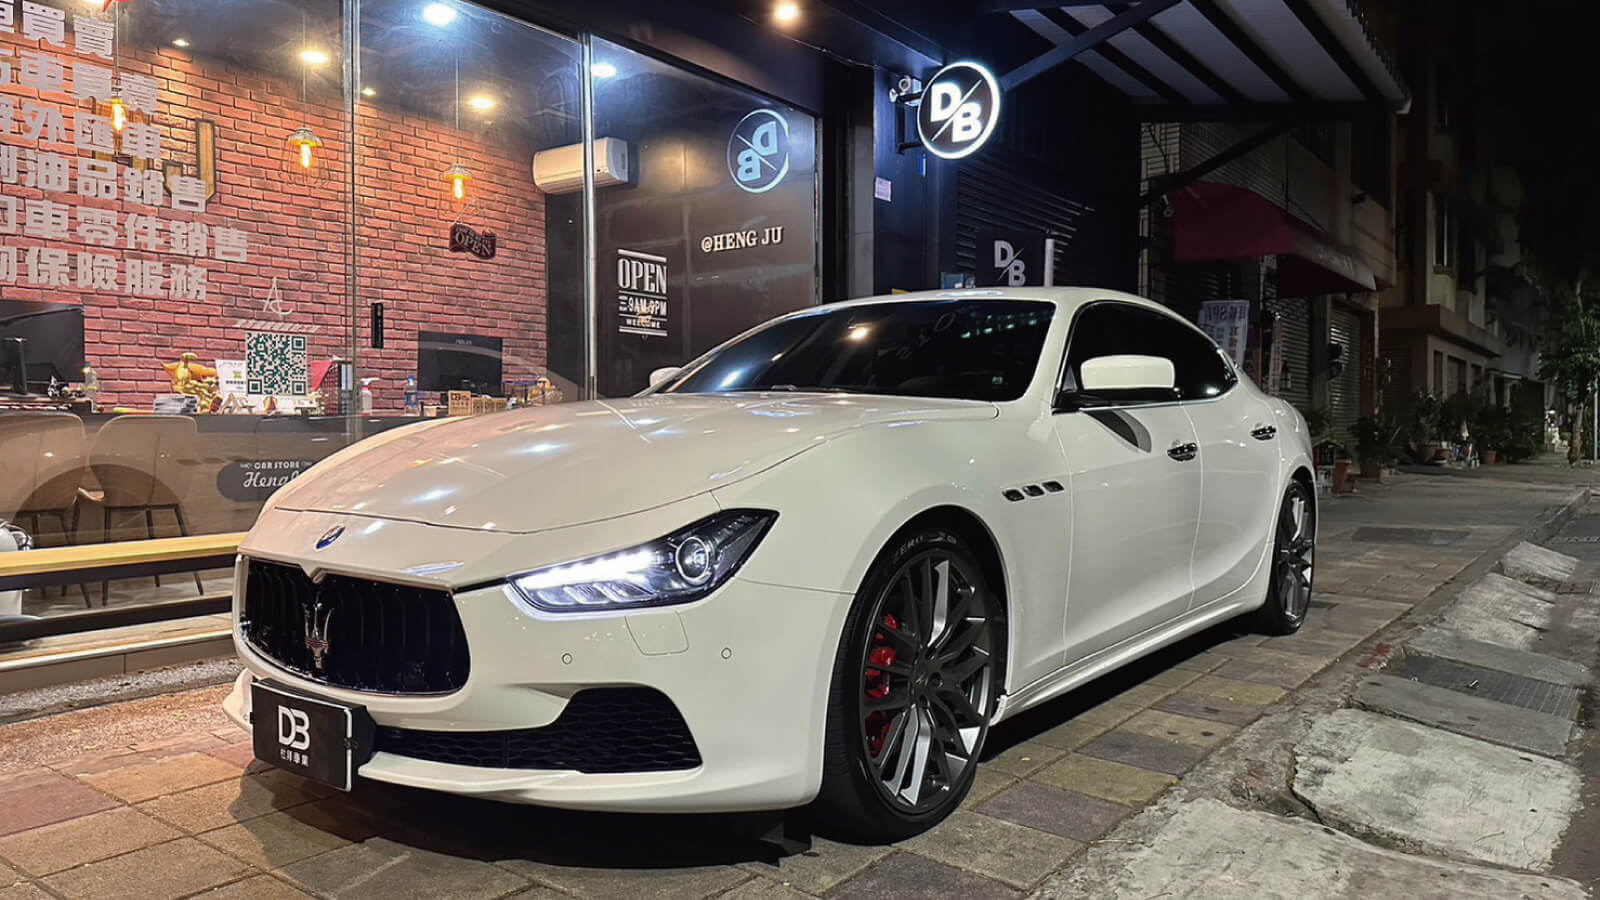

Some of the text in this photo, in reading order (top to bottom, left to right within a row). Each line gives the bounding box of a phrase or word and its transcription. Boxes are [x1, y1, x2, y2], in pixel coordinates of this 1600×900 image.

[455, 231, 491, 256] OPEN
[701, 226, 784, 253] @HENG JU
[617, 258, 668, 294] OPEN
[278, 705, 311, 750] DB
